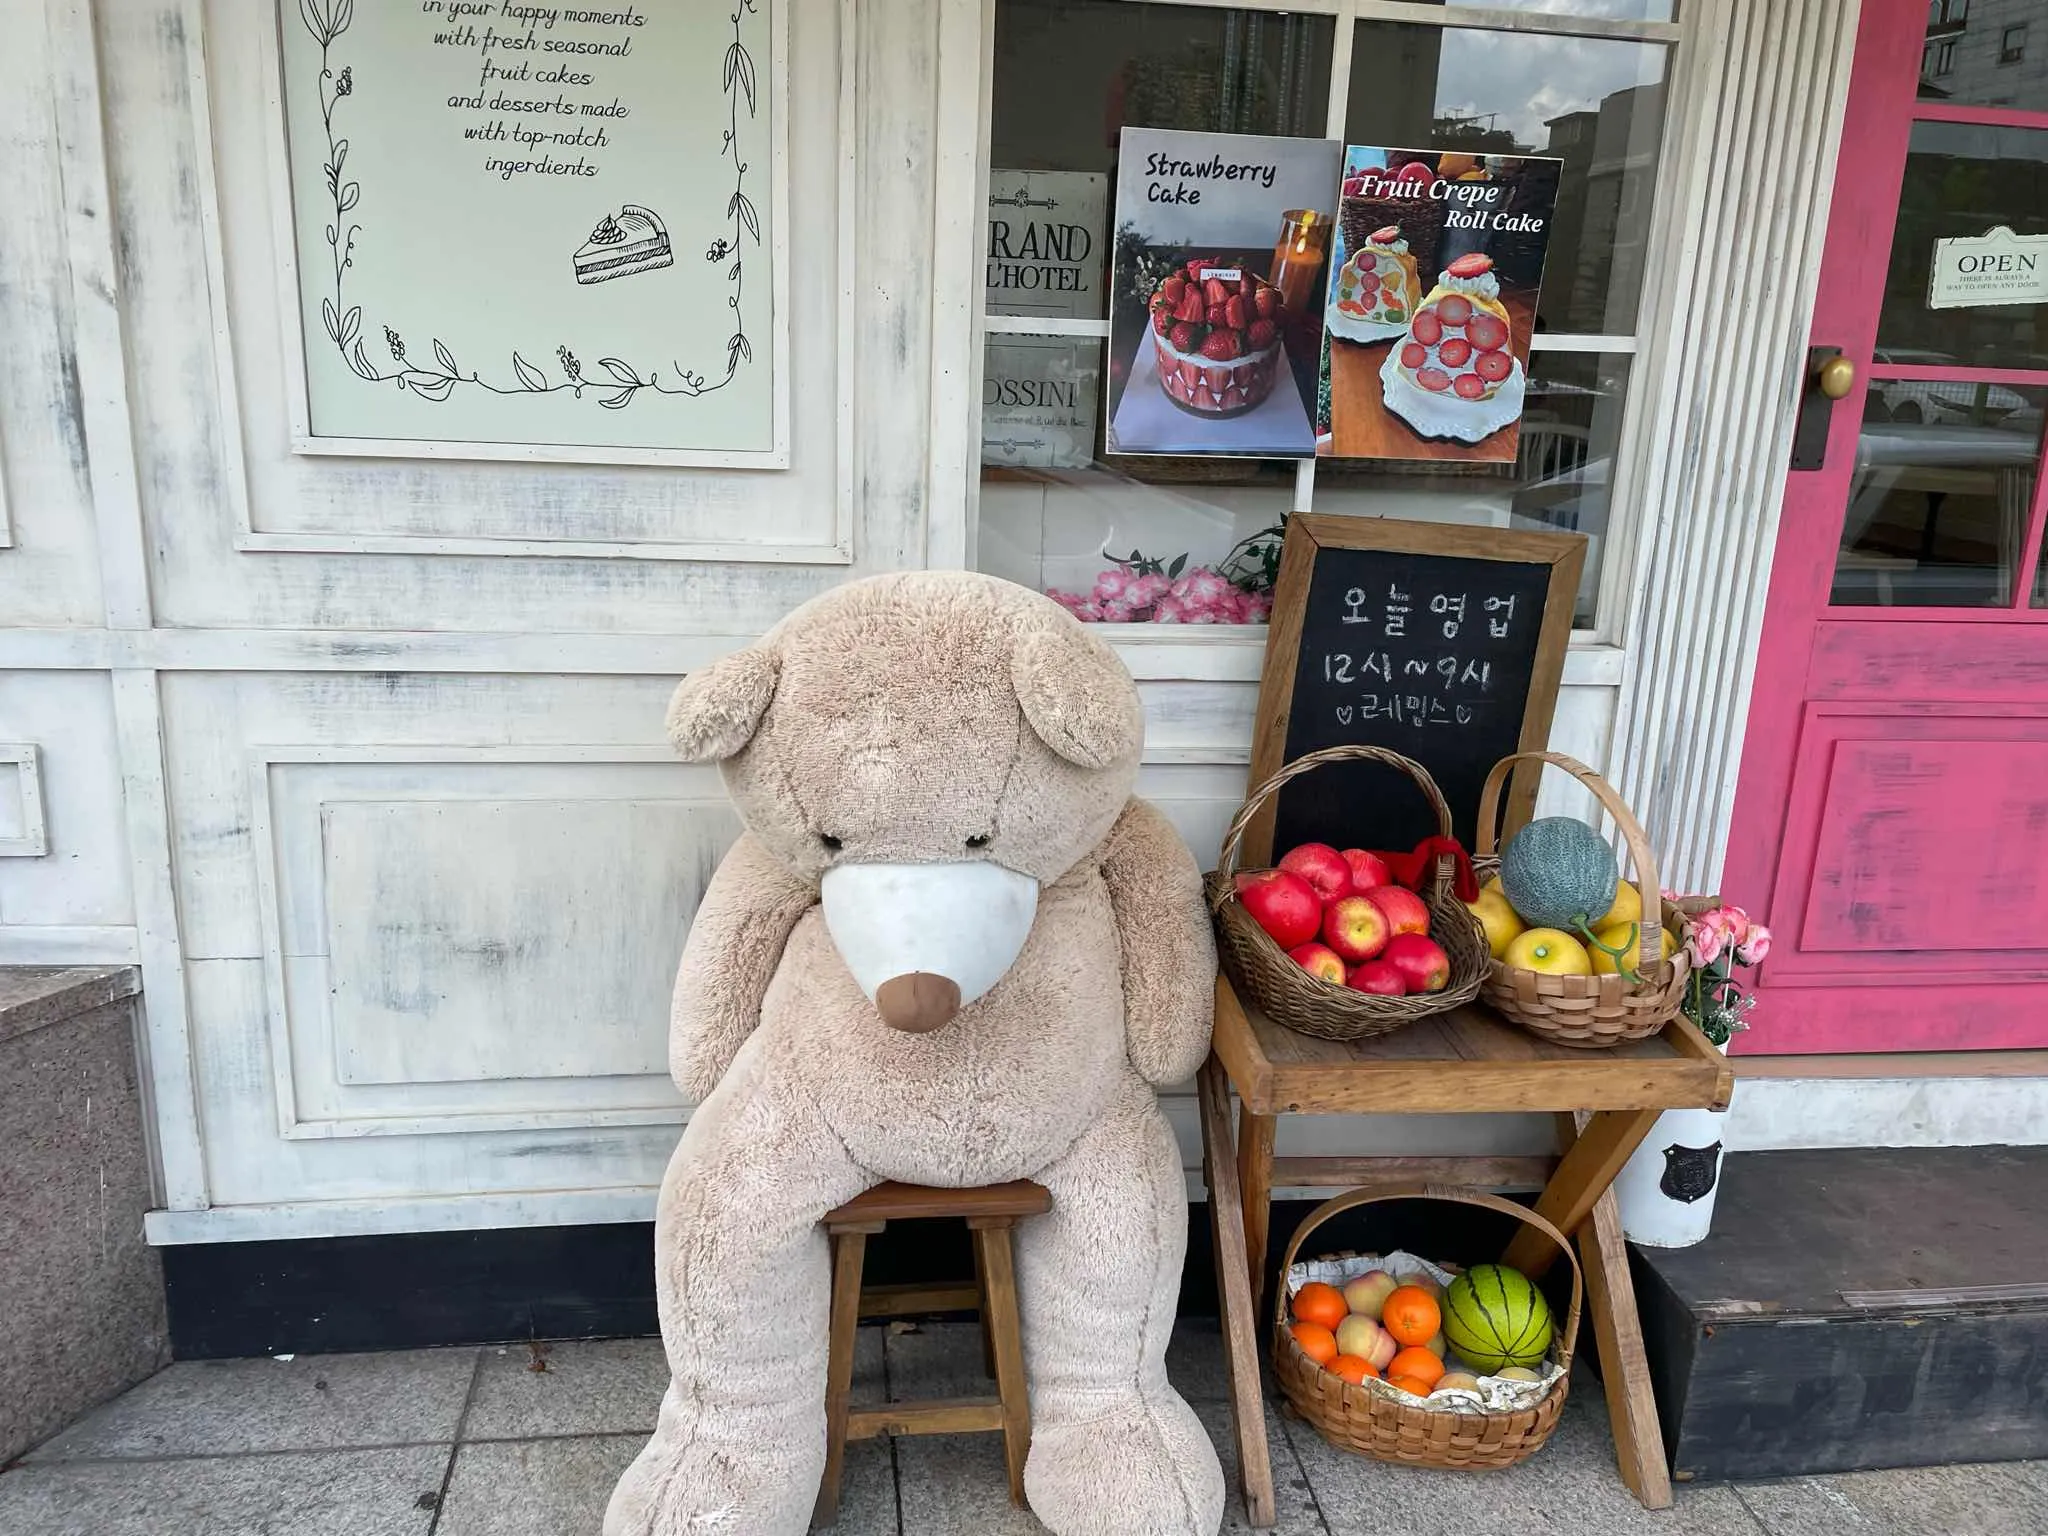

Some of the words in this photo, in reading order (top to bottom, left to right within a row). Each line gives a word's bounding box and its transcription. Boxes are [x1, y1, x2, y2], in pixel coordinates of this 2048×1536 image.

[423, 0, 443, 12] in
[448, 1, 496, 22] your
[501, 0, 560, 29] happy
[564, 6, 648, 27] moments
[434, 25, 480, 47] with
[481, 26, 539, 55] fresh
[543, 37, 632, 57] seasonal
[481, 58, 532, 87] fruit
[535, 64, 595, 86] cakes
[447, 90, 487, 109] and
[489, 90, 577, 115] desserts
[581, 98, 631, 118] made
[464, 121, 508, 141] with
[512, 122, 610, 152] top-notch
[485, 154, 600, 181] ingerdients
[1145, 152, 1276, 188] Strawberry
[1147, 181, 1201, 205] Cake
[1359, 174, 1425, 199] Fruit
[1429, 179, 1499, 208] Crepe
[1444, 210, 1487, 230] Roll
[1492, 213, 1544, 233] Cake
[986, 263, 1089, 292] L'HOTEL
[1958, 254, 2039, 273] OPEN
